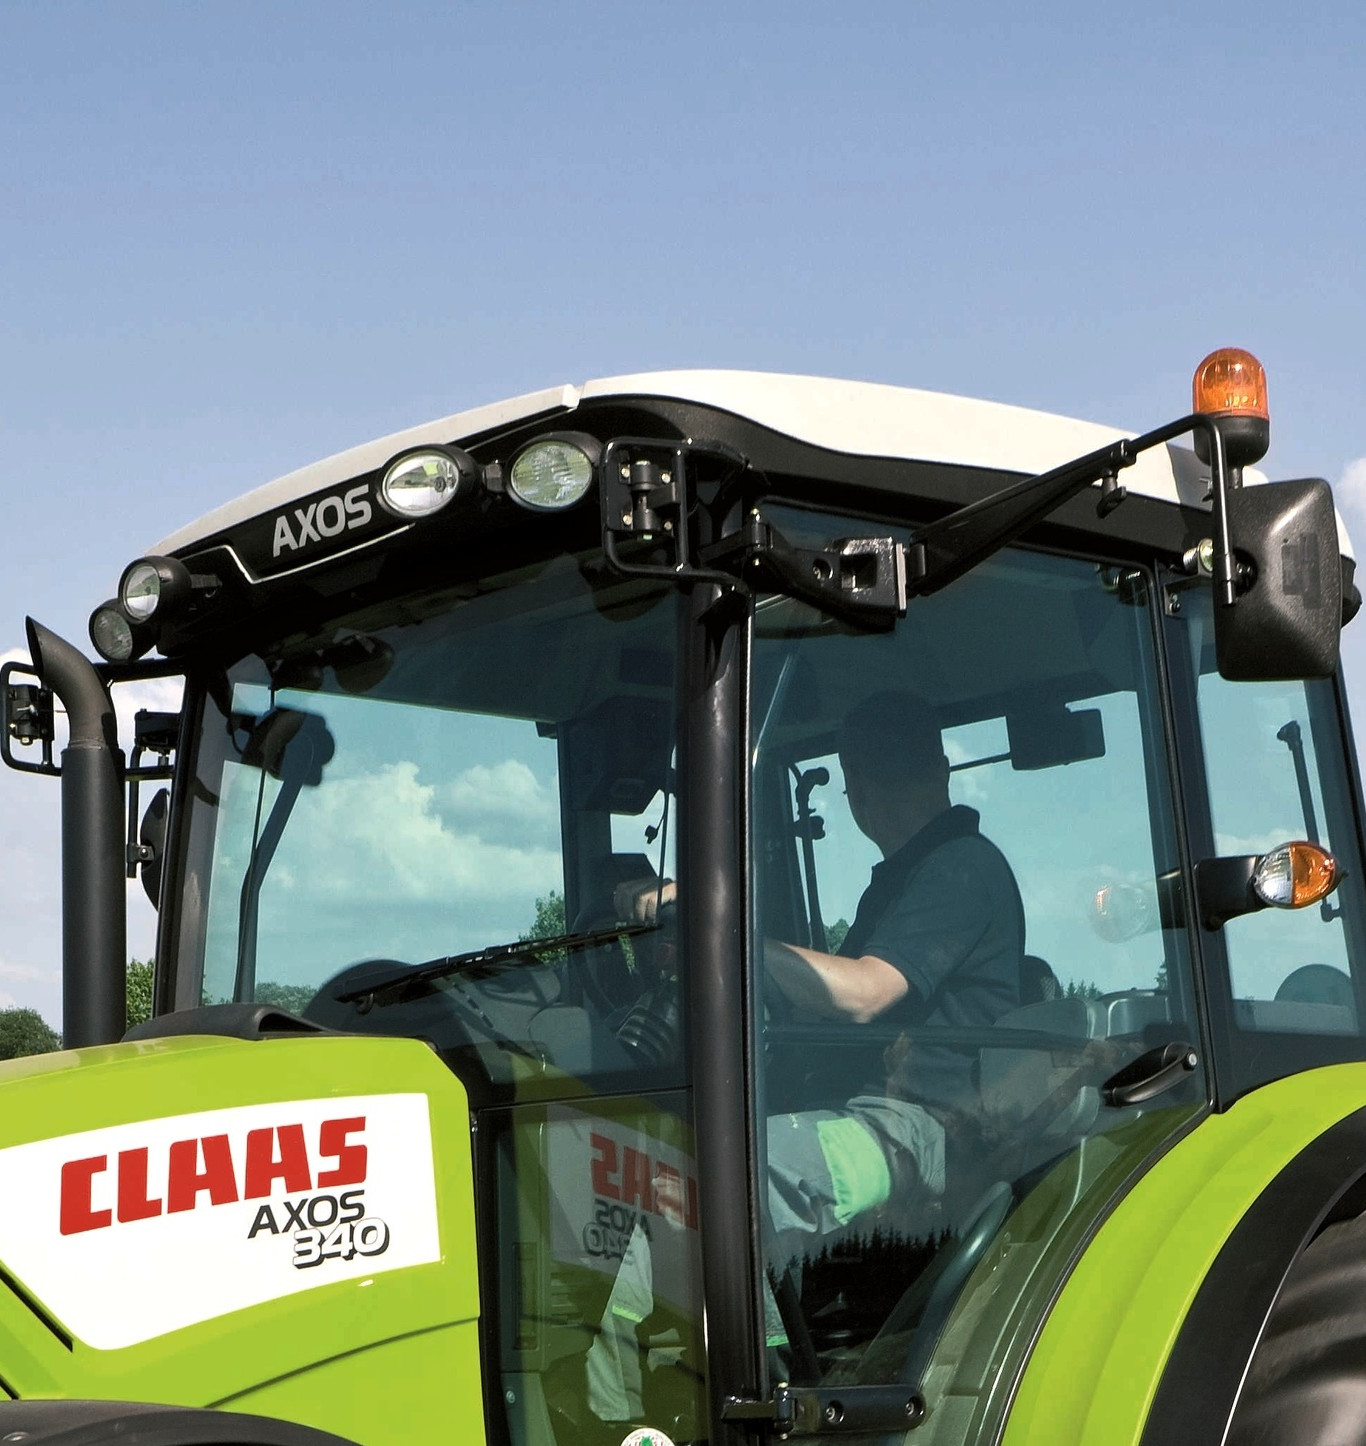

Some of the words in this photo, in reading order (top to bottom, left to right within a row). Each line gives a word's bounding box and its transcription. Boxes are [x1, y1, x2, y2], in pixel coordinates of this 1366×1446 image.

[272, 484, 372, 558] AXOS
[59, 1116, 367, 1236] CLAAS
[247, 1189, 366, 1239] AXOS
[292, 1216, 391, 1270] 340
